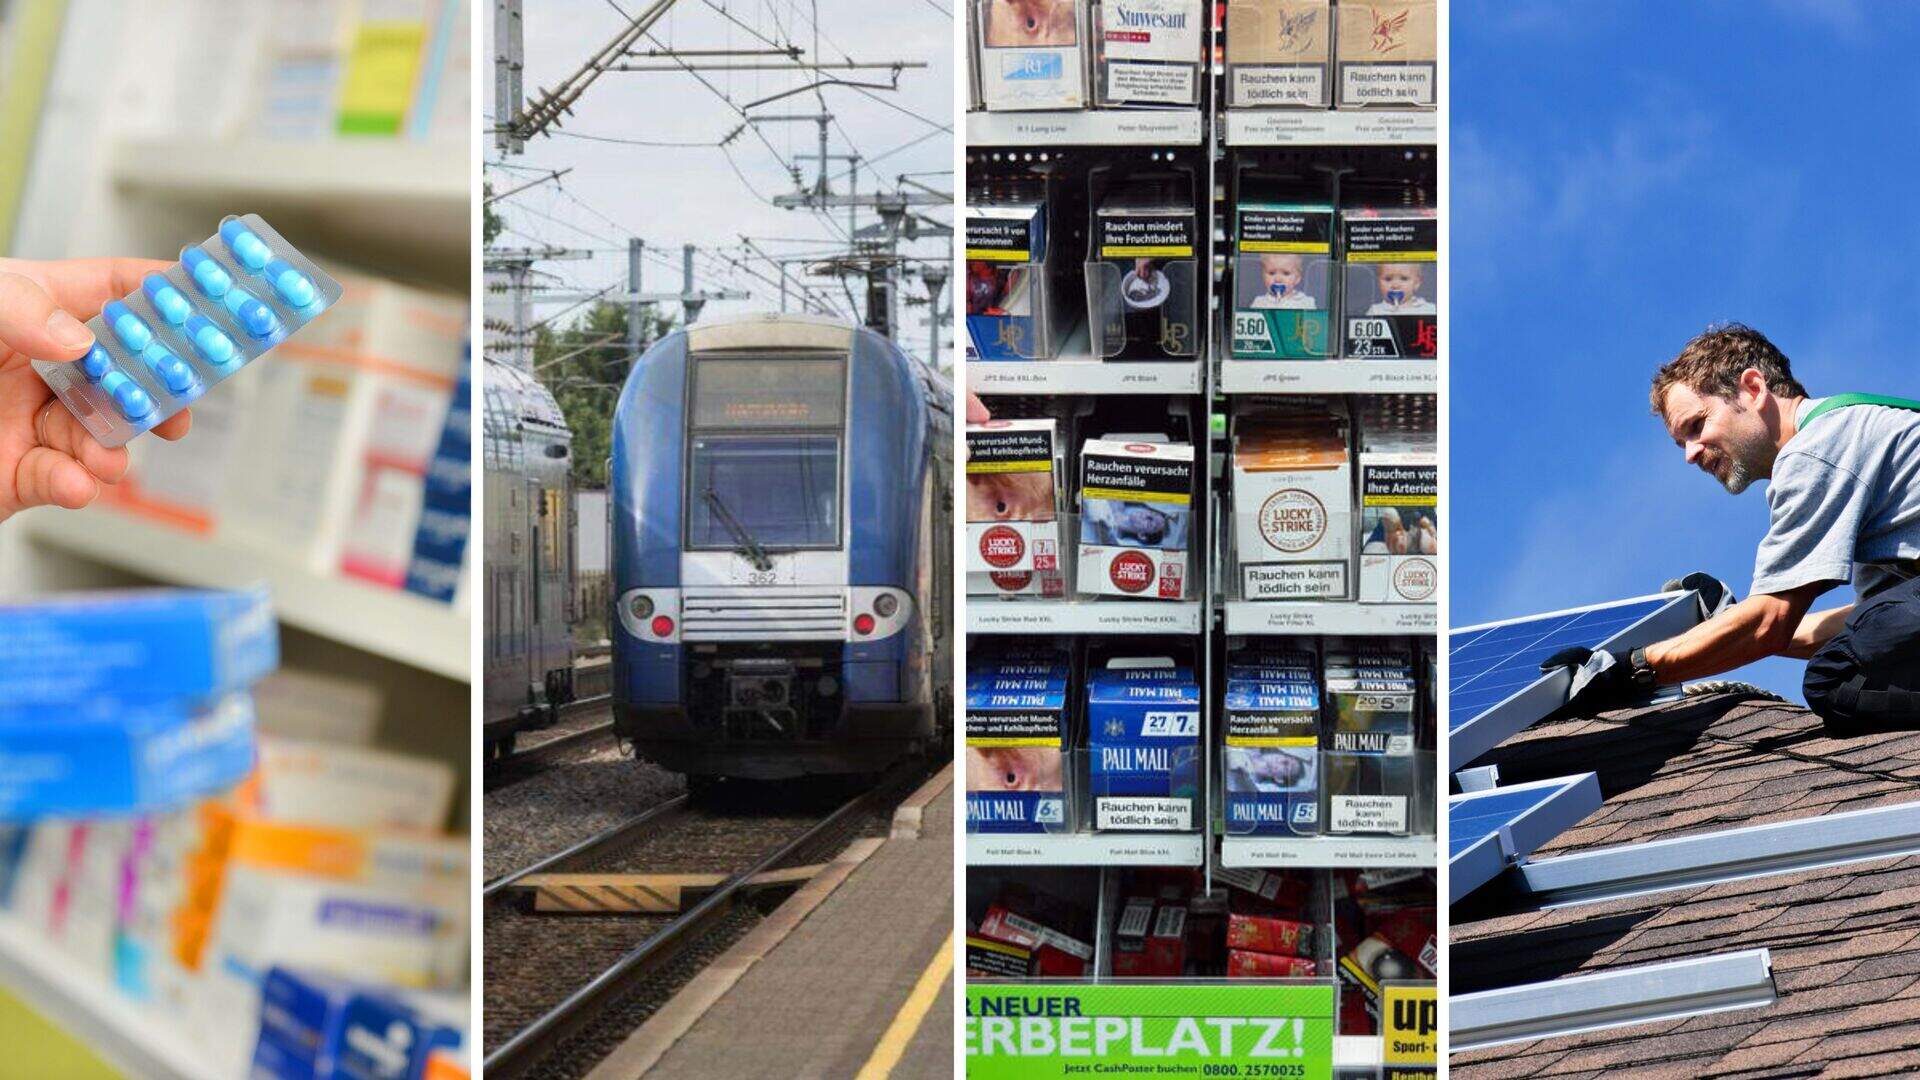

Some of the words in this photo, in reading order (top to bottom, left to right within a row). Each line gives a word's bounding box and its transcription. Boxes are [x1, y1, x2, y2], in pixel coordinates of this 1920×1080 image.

[1240, 73, 1287, 84] Rauchen
[1289, 74, 1316, 84] kann
[1350, 71, 1397, 82] Rauchen
[1399, 72, 1426, 83] kann
[1286, 90, 1309, 99] sein
[1396, 88, 1419, 97] sein
[1003, 226, 1010, 235] 9
[1105, 221, 1145, 231] Rauchen
[1146, 221, 1184, 231] mindert
[1105, 234, 1124, 244] Ihre
[1126, 234, 1188, 244] Fruchtbarkeit
[1236, 318, 1265, 335] 5.60
[1354, 321, 1383, 337] 6.00
[1354, 340, 1371, 355] 23
[992, 447, 1048, 456] Kehlkopfkrebs
[1087, 460, 1131, 472] Rauchen
[1134, 465, 1189, 476] verursacht
[1367, 468, 1416, 480] Rauchen
[1417, 470, 1437, 480] ver
[1087, 473, 1146, 487] Herzanfälle
[1367, 482, 1390, 494] Ihre
[1391, 482, 1437, 494] Arterien
[1273, 508, 1312, 520] LUCKY
[1272, 521, 1314, 533] STRIKE
[988, 539, 1015, 547] LUCKY
[987, 547, 1017, 556] STRIKE
[1035, 557, 1049, 569] 25
[1119, 563, 1147, 572] LUCKY
[749, 573, 776, 584] 362
[1117, 571, 1147, 580] STRIKE
[1249, 570, 1305, 580] Rauchen
[1308, 569, 1340, 579] kann
[1259, 583, 1301, 593] tödlich
[1304, 583, 1331, 592] sein
[1125, 671, 1151, 680] MALL
[1154, 671, 1177, 679] PALL
[996, 680, 1021, 690] MALL
[1024, 680, 1047, 690] PALL
[1261, 684, 1287, 694] MALL
[1290, 685, 1313, 694] PALL
[1129, 687, 1156, 697] MALL
[1159, 687, 1182, 697] PALL
[992, 695, 1019, 705] MALL
[1021, 695, 1046, 705] PALL
[1260, 696, 1286, 706] MALL
[1289, 697, 1312, 706] PALL
[1150, 716, 1167, 727] 27
[1230, 715, 1267, 723] Rauchen
[1268, 715, 1314, 724] verursacht
[1004, 724, 1058, 733] Kehlkopfkrebs
[1335, 733, 1357, 750] PALL
[1359, 734, 1384, 751] MALL
[1102, 747, 1133, 771] PALL
[1135, 747, 1171, 771] MALL
[1101, 802, 1154, 812] Rauchen
[1158, 802, 1188, 813] kann
[1345, 799, 1393, 808] Rauchen
[966, 800, 993, 820] PALL
[994, 800, 1025, 820] MALL
[1233, 803, 1255, 820] PALL
[1257, 803, 1284, 821] MALL
[1355, 809, 1382, 818] kann
[1110, 814, 1151, 825] tödlich
[1153, 816, 1179, 826] sein
[1338, 819, 1374, 828] tödlich
[1377, 820, 1399, 828] sein
[981, 997, 1082, 1017] NEUER
[1394, 999, 1437, 1035] up
[1394, 1040, 1430, 1053] Sport-
[1064, 1063, 1091, 1074] Jetzt
[1093, 1063, 1153, 1073] CashPoster
[1157, 1063, 1198, 1073] buchen
